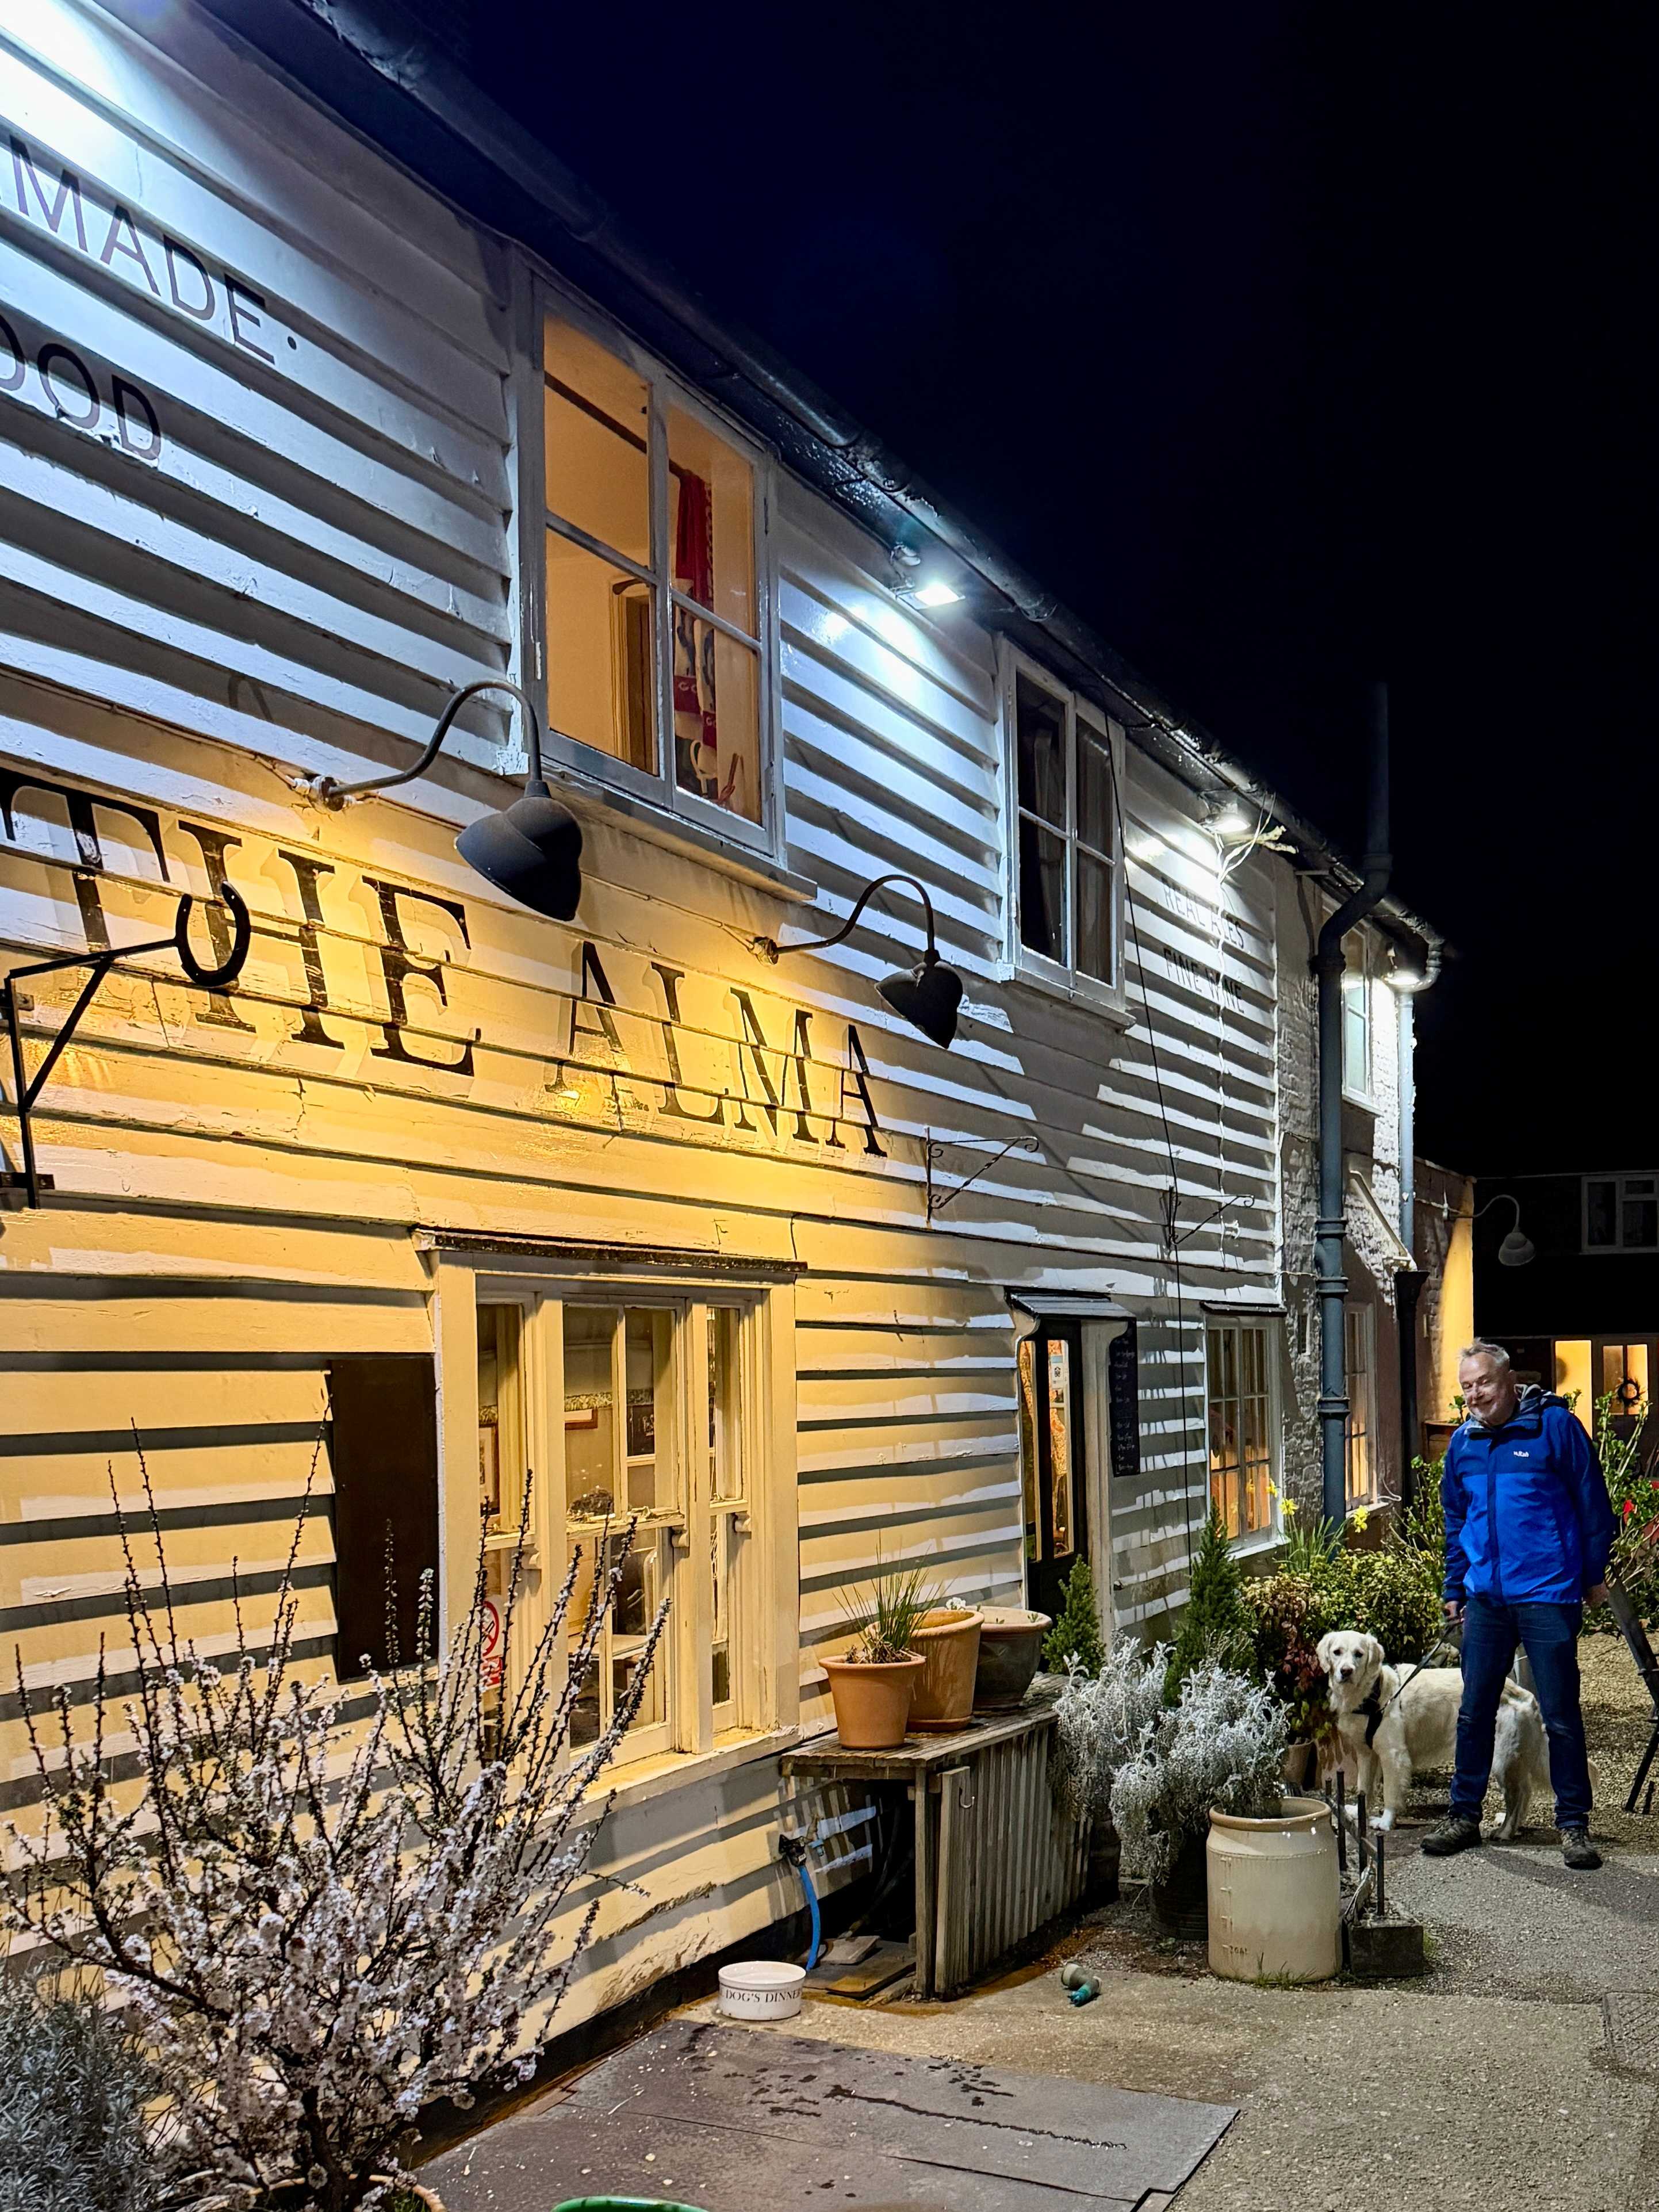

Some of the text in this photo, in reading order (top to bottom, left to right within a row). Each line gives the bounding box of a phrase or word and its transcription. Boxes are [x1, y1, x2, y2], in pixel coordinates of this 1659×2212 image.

[1161, 877, 1206, 927] REAL
[0, 767, 887, 1157] THE ALMA
[1163, 948, 1202, 992] FINE
[725, 1988, 801, 2003] DOG'S DINNE
